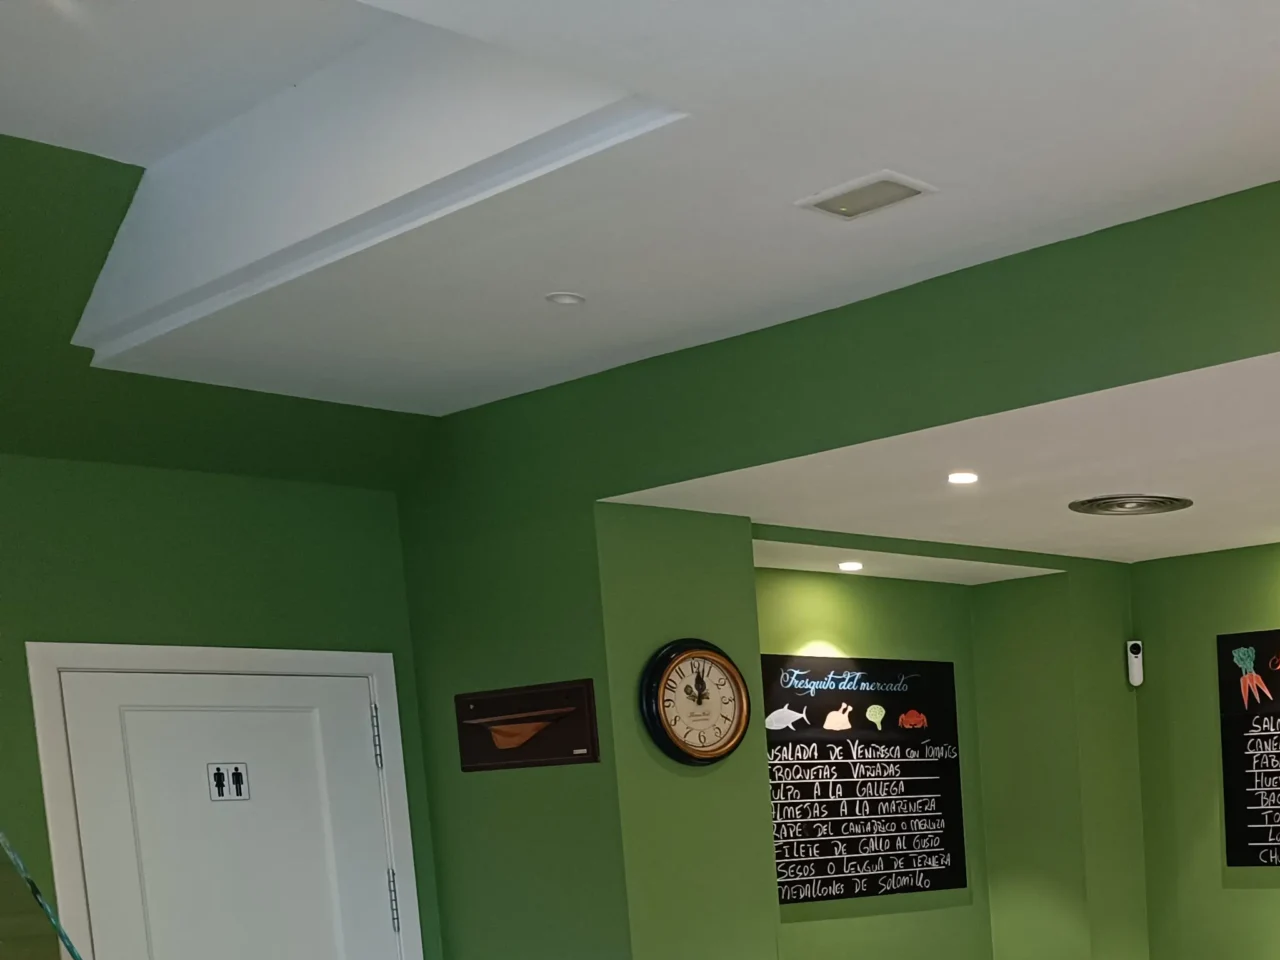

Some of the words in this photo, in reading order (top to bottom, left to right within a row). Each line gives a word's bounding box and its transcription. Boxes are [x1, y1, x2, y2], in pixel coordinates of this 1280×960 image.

[675, 666, 685, 680] 11
[690, 660, 700, 674] 12
[706, 665, 713, 678] 1
[665, 678, 678, 693] 10
[716, 677, 726, 690] 2
[780, 668, 836, 697] Fresquito
[839, 671, 863, 690] del
[860, 674, 909, 691] mercado
[663, 698, 675, 709] 9
[721, 695, 734, 705] 3
[670, 715, 680, 727] 8
[720, 713, 732, 724] 4
[683, 726, 693, 739] 7
[698, 730, 707, 744] 6
[713, 724, 722, 738] 5
[767, 742, 818, 761] NSALADA
[826, 744, 843, 760] DE
[847, 739, 900, 760] VENTRESCA
[905, 747, 920, 758] CON
[921, 739, 958, 759] TOMATES
[769, 765, 837, 780] ROQUETAS
[848, 762, 901, 779] VARIADAS
[814, 782, 820, 799] A
[828, 781, 843, 799] LA
[856, 780, 904, 798] GALLEGA
[840, 800, 847, 816] A
[856, 800, 869, 816] LA
[878, 798, 936, 814] MARINERA
[813, 822, 834, 837] DEL
[910, 819, 945, 831] MERLUZA
[831, 840, 847, 856] DE
[859, 836, 890, 854] GALLO
[896, 836, 907, 850] AL
[913, 835, 940, 850] GUSTO
[777, 863, 815, 879] SESOS
[827, 862, 835, 874] O
[844, 856, 883, 873] LENGUA
[890, 856, 904, 869] DE
[909, 853, 950, 868] TERNERA
[852, 878, 867, 893] DE
